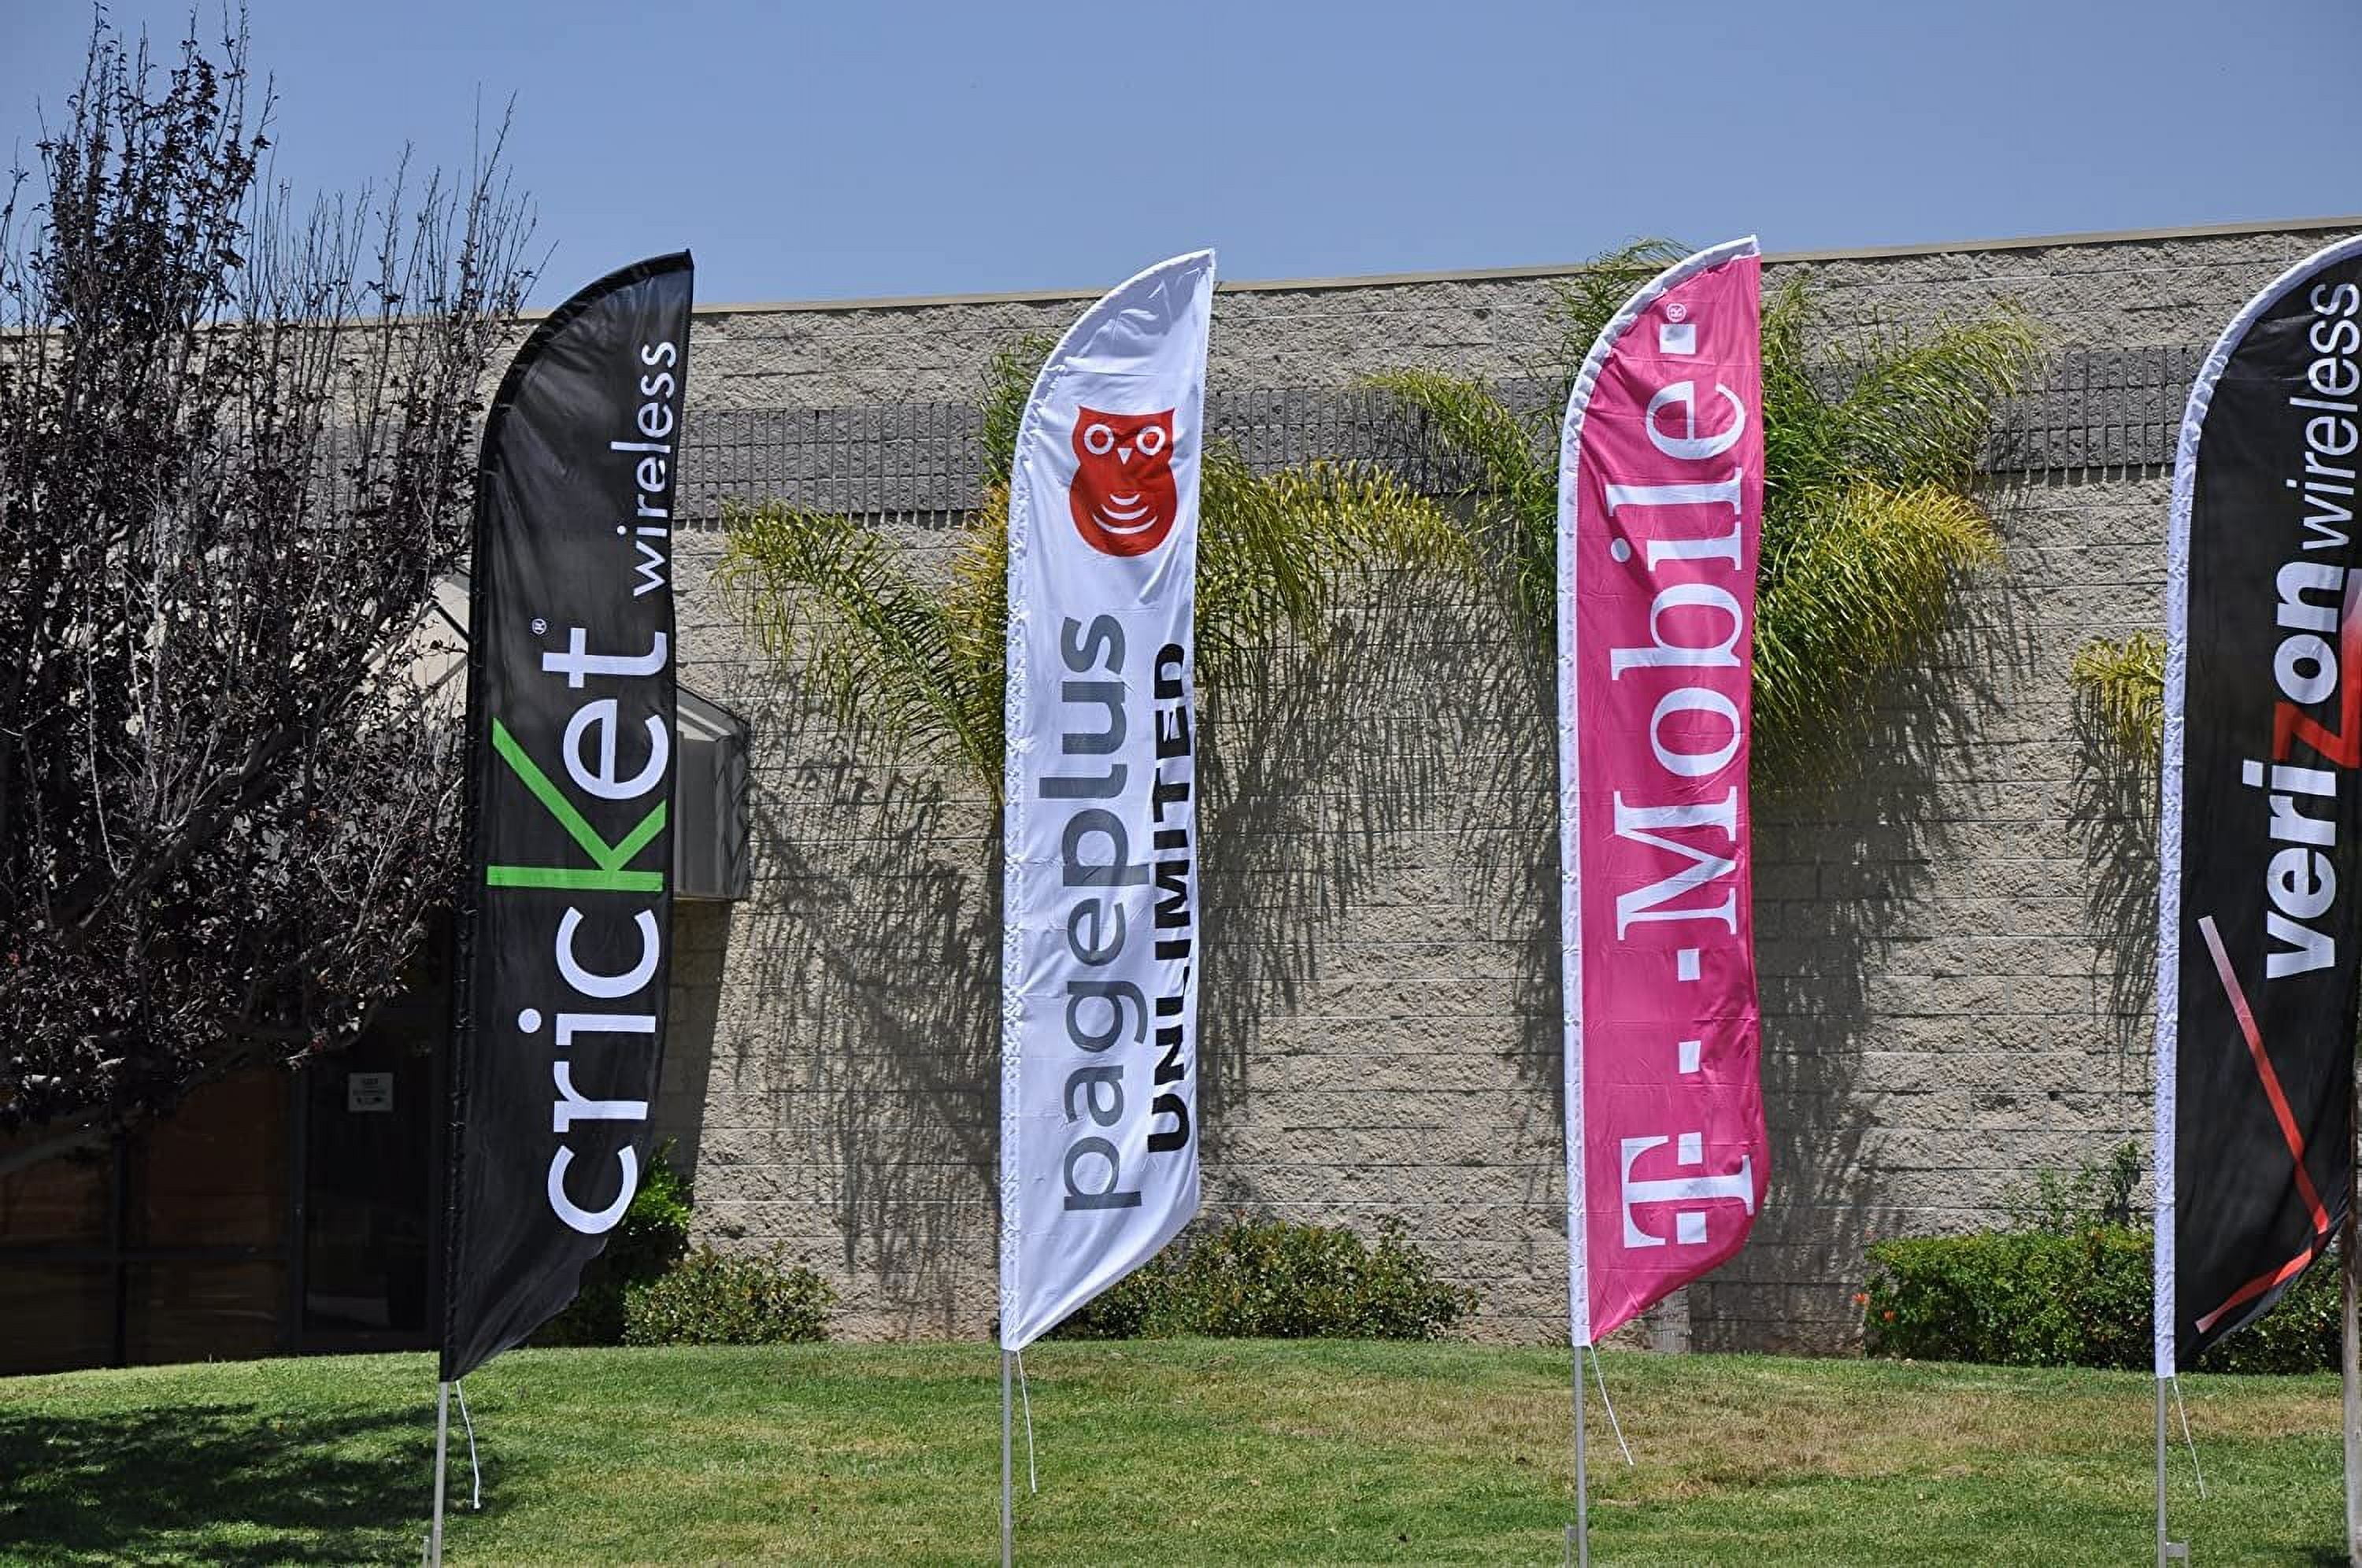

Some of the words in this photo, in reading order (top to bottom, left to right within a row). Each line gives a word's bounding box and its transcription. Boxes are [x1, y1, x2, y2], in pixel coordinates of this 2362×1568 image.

[609, 340, 677, 597] wireless
[2286, 283, 2362, 550] wireless
[1038, 613, 1150, 1211] pageplus
[1146, 642, 1192, 1153] UNLIMITED
[2242, 560, 2362, 979] verizon
